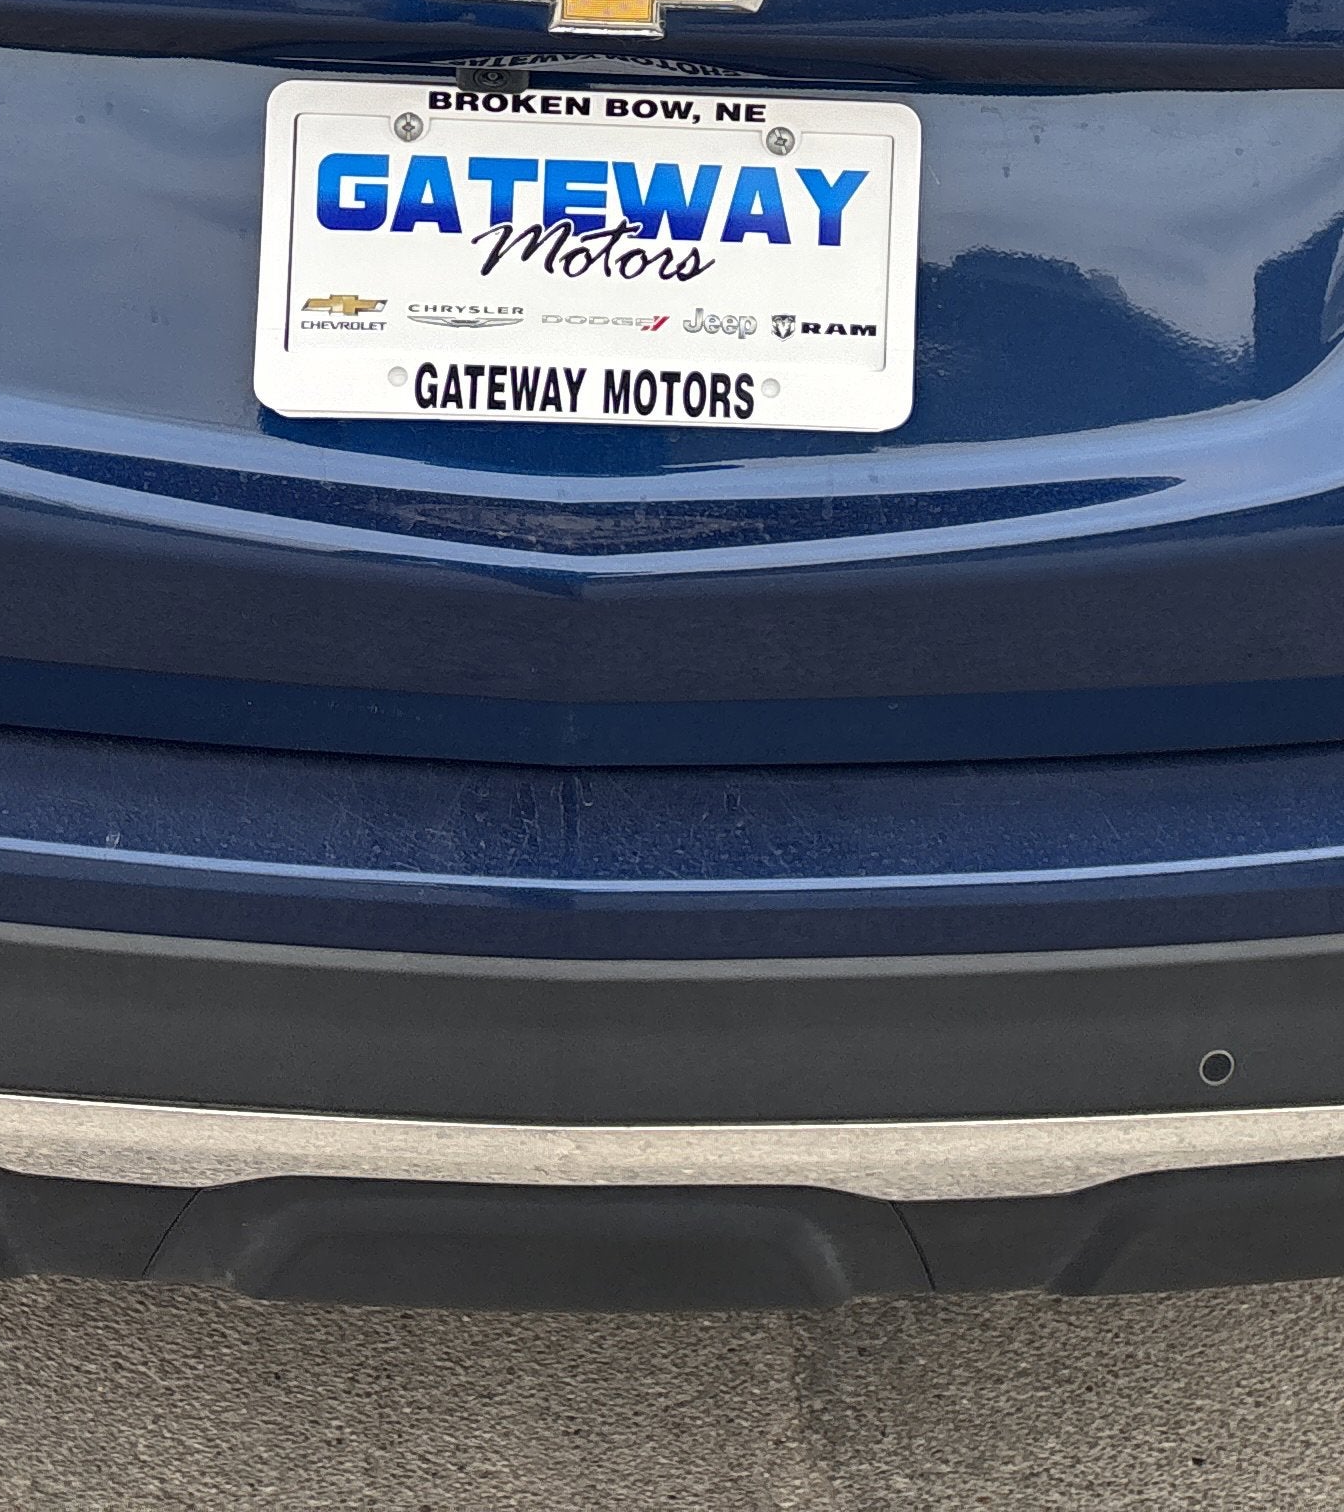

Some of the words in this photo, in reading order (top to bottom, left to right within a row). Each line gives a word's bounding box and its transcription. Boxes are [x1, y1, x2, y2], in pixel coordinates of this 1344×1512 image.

[428, 90, 591, 117] BROKEN
[605, 97, 702, 124] BOW,
[715, 102, 767, 124] NE
[316, 152, 871, 247] GATEWAY
[471, 218, 717, 282] Motors
[300, 320, 388, 331] CHEVROLET
[407, 303, 525, 316] CHRYSLER
[541, 314, 657, 328] DODGE
[682, 307, 758, 339] Jeep
[800, 321, 878, 337] RAM
[414, 361, 588, 413] GATEWAY
[602, 368, 755, 420] MOTORS
